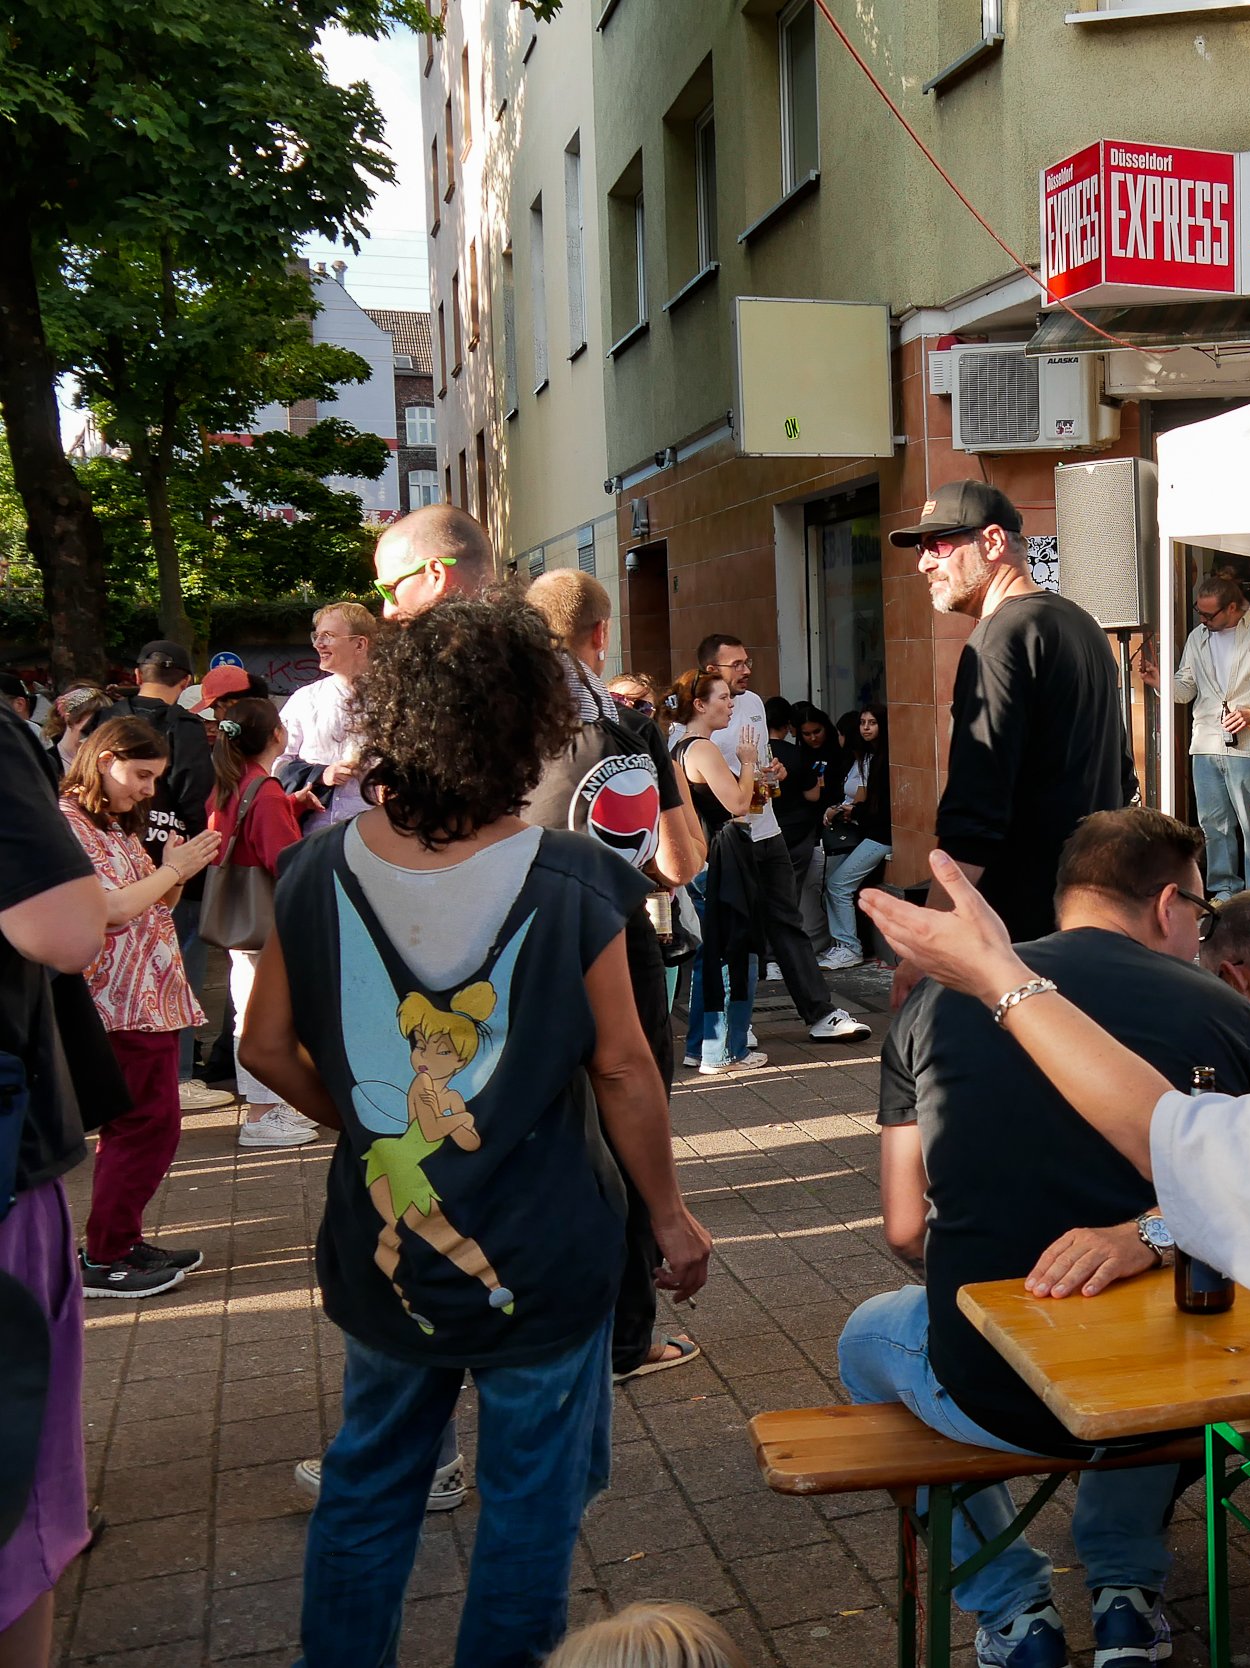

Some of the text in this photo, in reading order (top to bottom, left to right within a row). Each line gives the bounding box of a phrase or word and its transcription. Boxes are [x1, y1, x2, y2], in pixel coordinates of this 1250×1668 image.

[1110, 148, 1173, 172] Düsseldorf
[1047, 163, 1074, 193] Düsseldorf
[1047, 174, 1100, 279] EXPRESS
[1110, 171, 1229, 267] EXPRESS
[1047, 357, 1080, 365] ALASKA
[785, 418, 799, 438] OK
